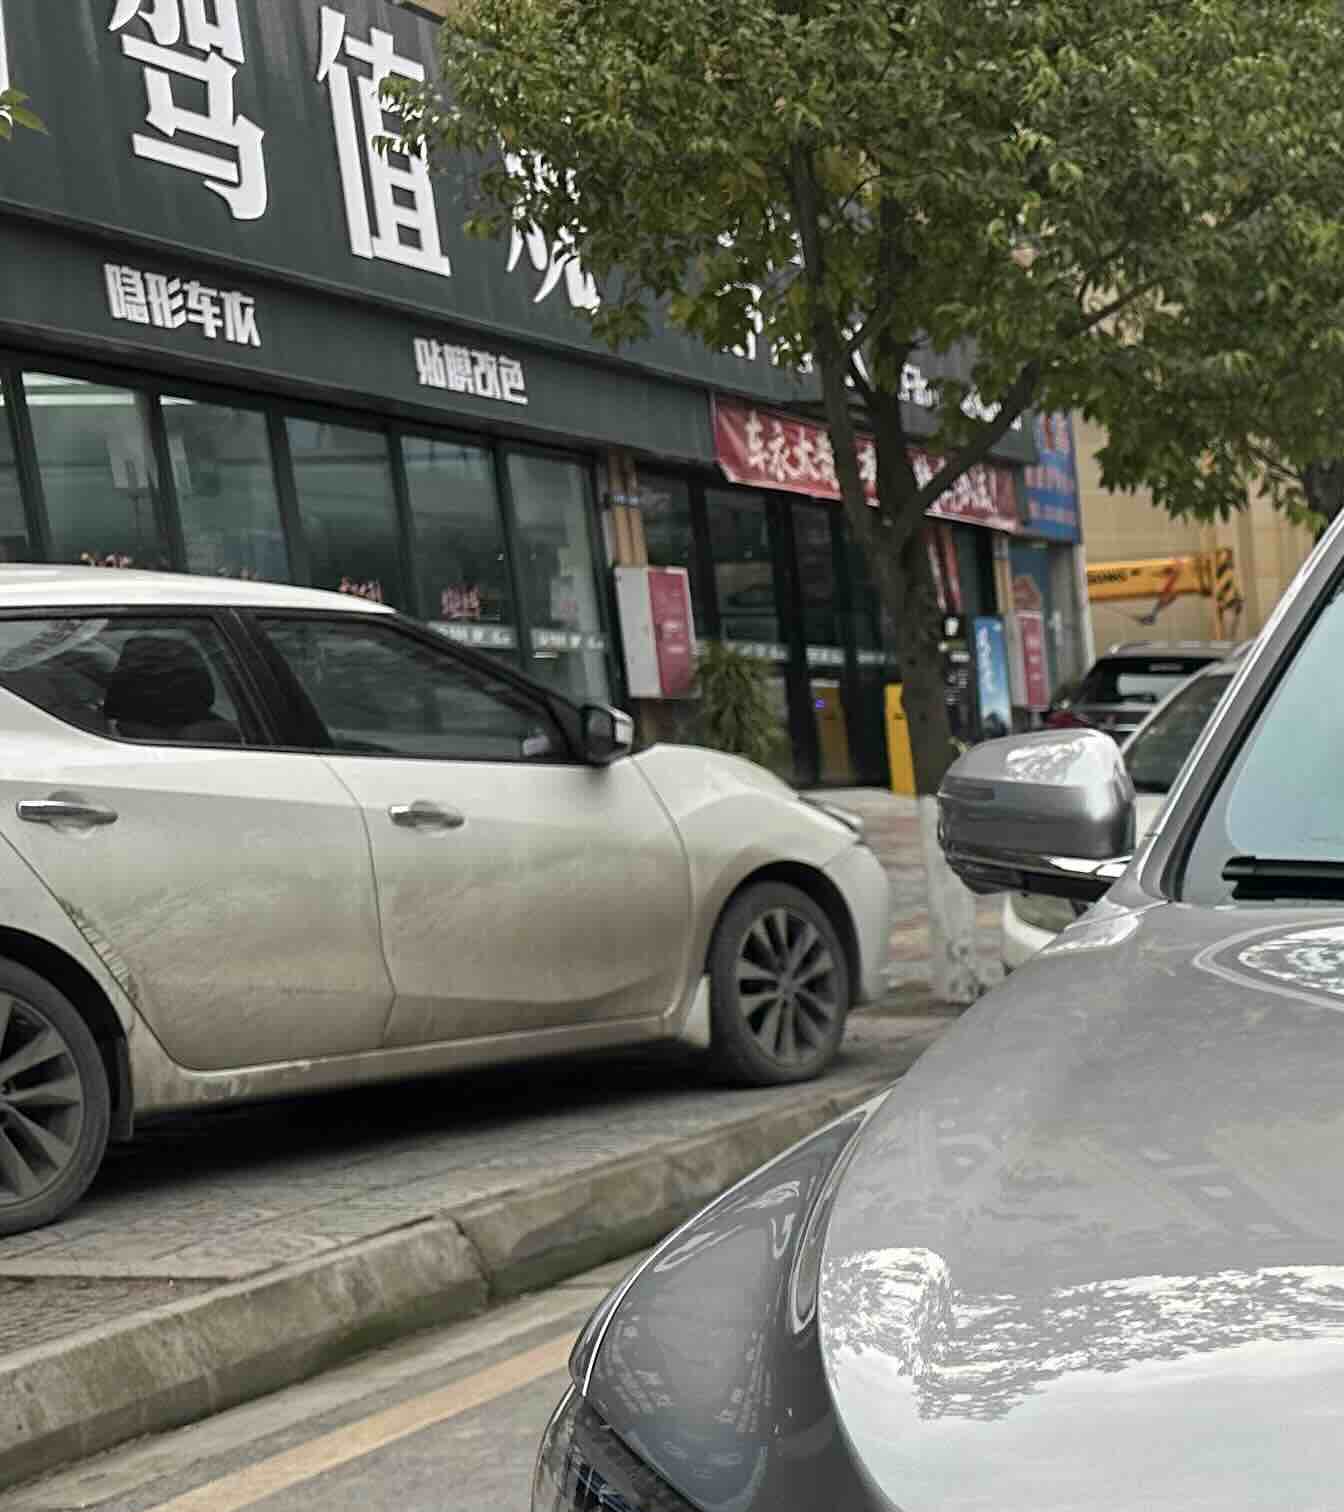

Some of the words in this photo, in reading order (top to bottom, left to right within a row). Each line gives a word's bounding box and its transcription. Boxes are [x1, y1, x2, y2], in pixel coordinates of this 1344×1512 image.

[103, 263, 262, 347] 隐形车衣
[413, 338, 529, 405] 贴膜改色
